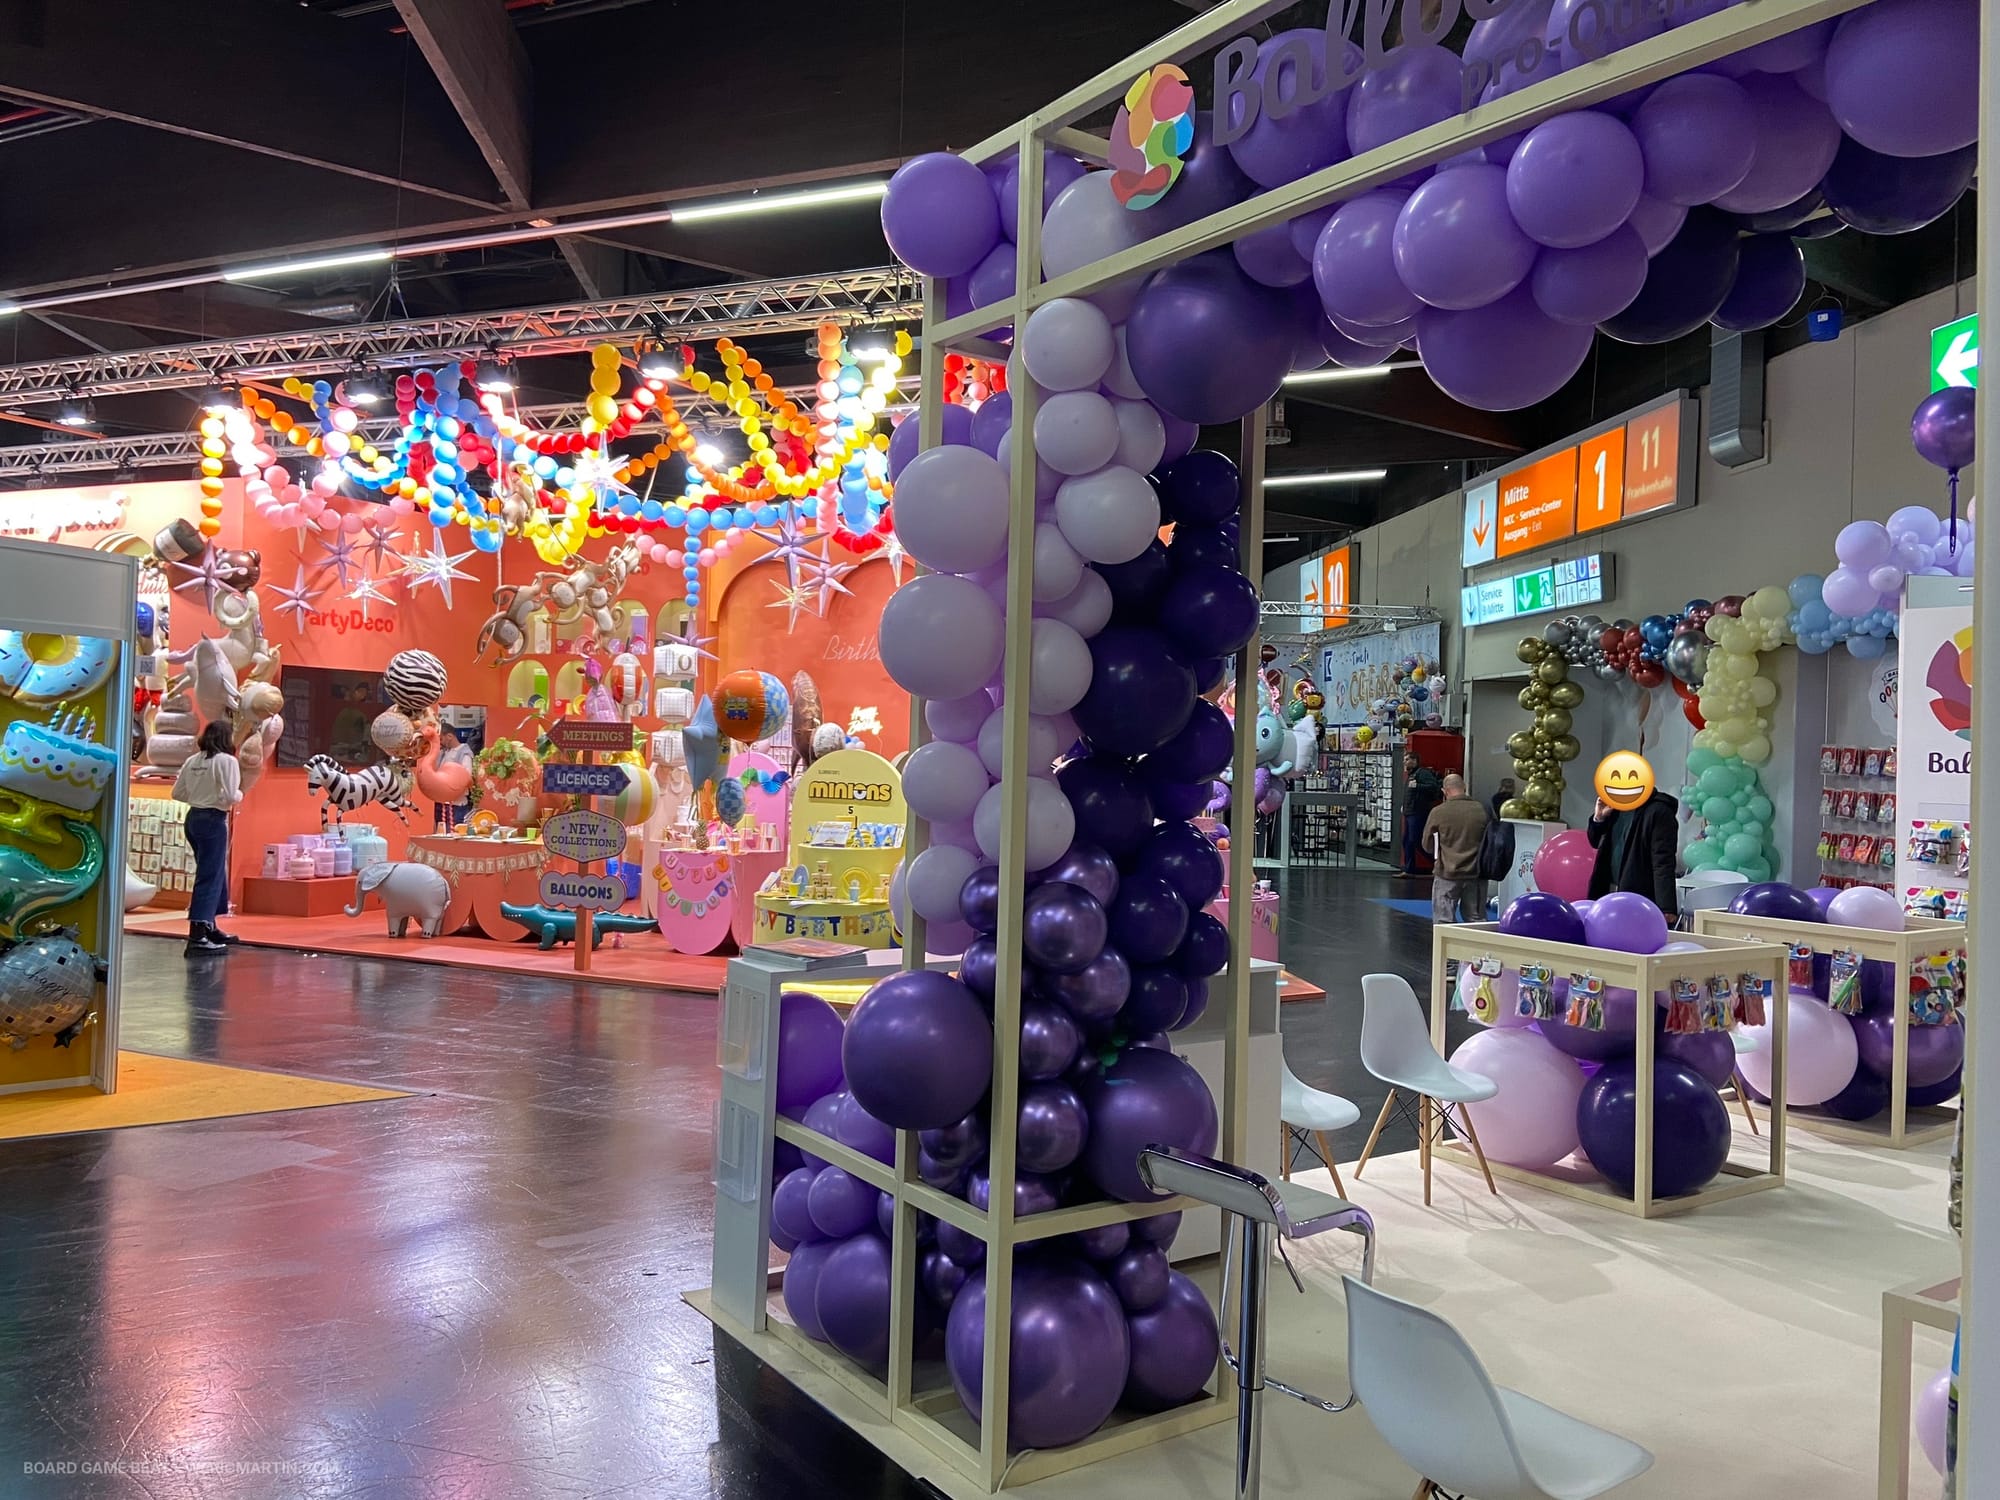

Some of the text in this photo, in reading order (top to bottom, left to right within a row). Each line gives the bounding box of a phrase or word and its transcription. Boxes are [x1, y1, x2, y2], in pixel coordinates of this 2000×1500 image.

[1213, 0, 1501, 146] Ballo
[1641, 424, 1659, 472] 11
[1594, 450, 1606, 511] 1
[1504, 485, 1530, 507] Mitte
[1519, 499, 1562, 521] Service-Center
[1503, 526, 1529, 542] Ausgang
[1328, 561, 1344, 614] 10
[1481, 588, 1503, 600] Service
[563, 730, 625, 742] MEETINGS
[557, 772, 610, 786] LICENCES
[848, 805, 854, 815] 5
[569, 823, 600, 835] NEW
[550, 835, 618, 848] COLLECTIONS
[550, 883, 613, 900] BALLOONS
